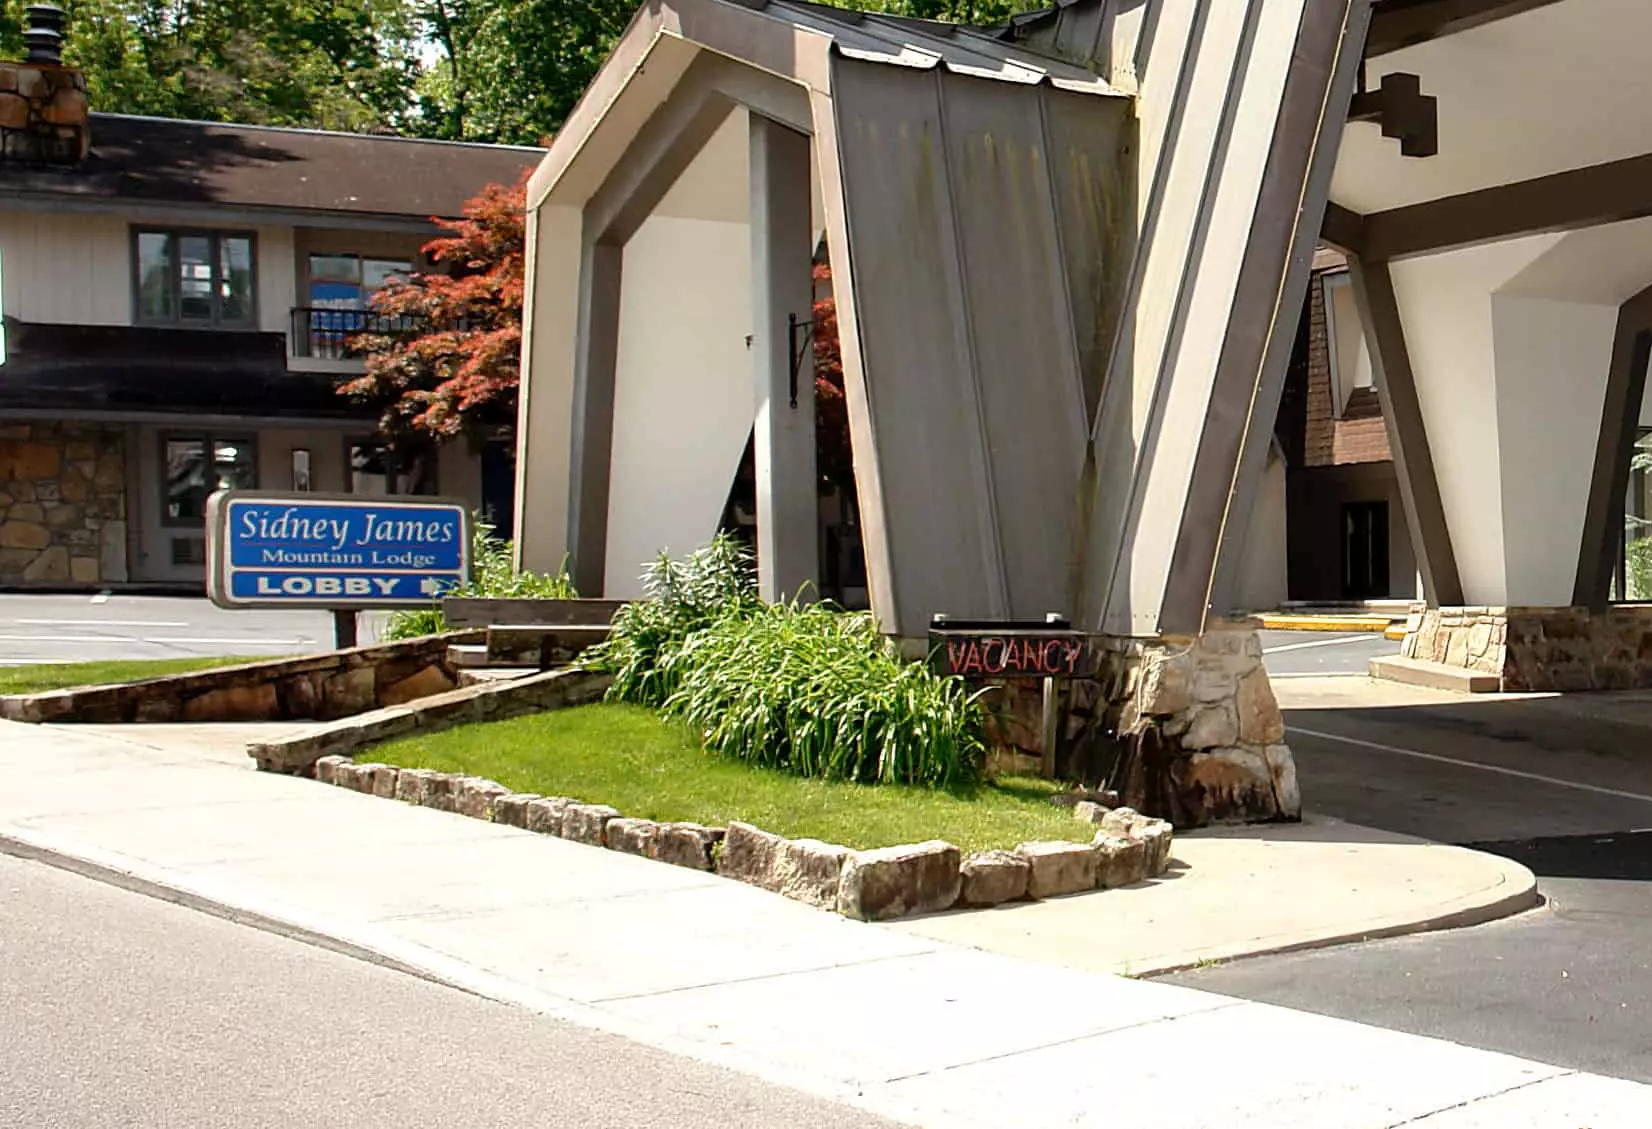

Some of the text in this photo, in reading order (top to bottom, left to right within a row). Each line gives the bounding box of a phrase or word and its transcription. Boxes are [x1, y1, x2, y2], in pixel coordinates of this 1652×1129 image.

[239, 508, 454, 551] Sidney James
[261, 549, 436, 568] Mountain Lodge
[257, 576, 400, 595] LOBBY
[947, 638, 1083, 673] VACANCY
